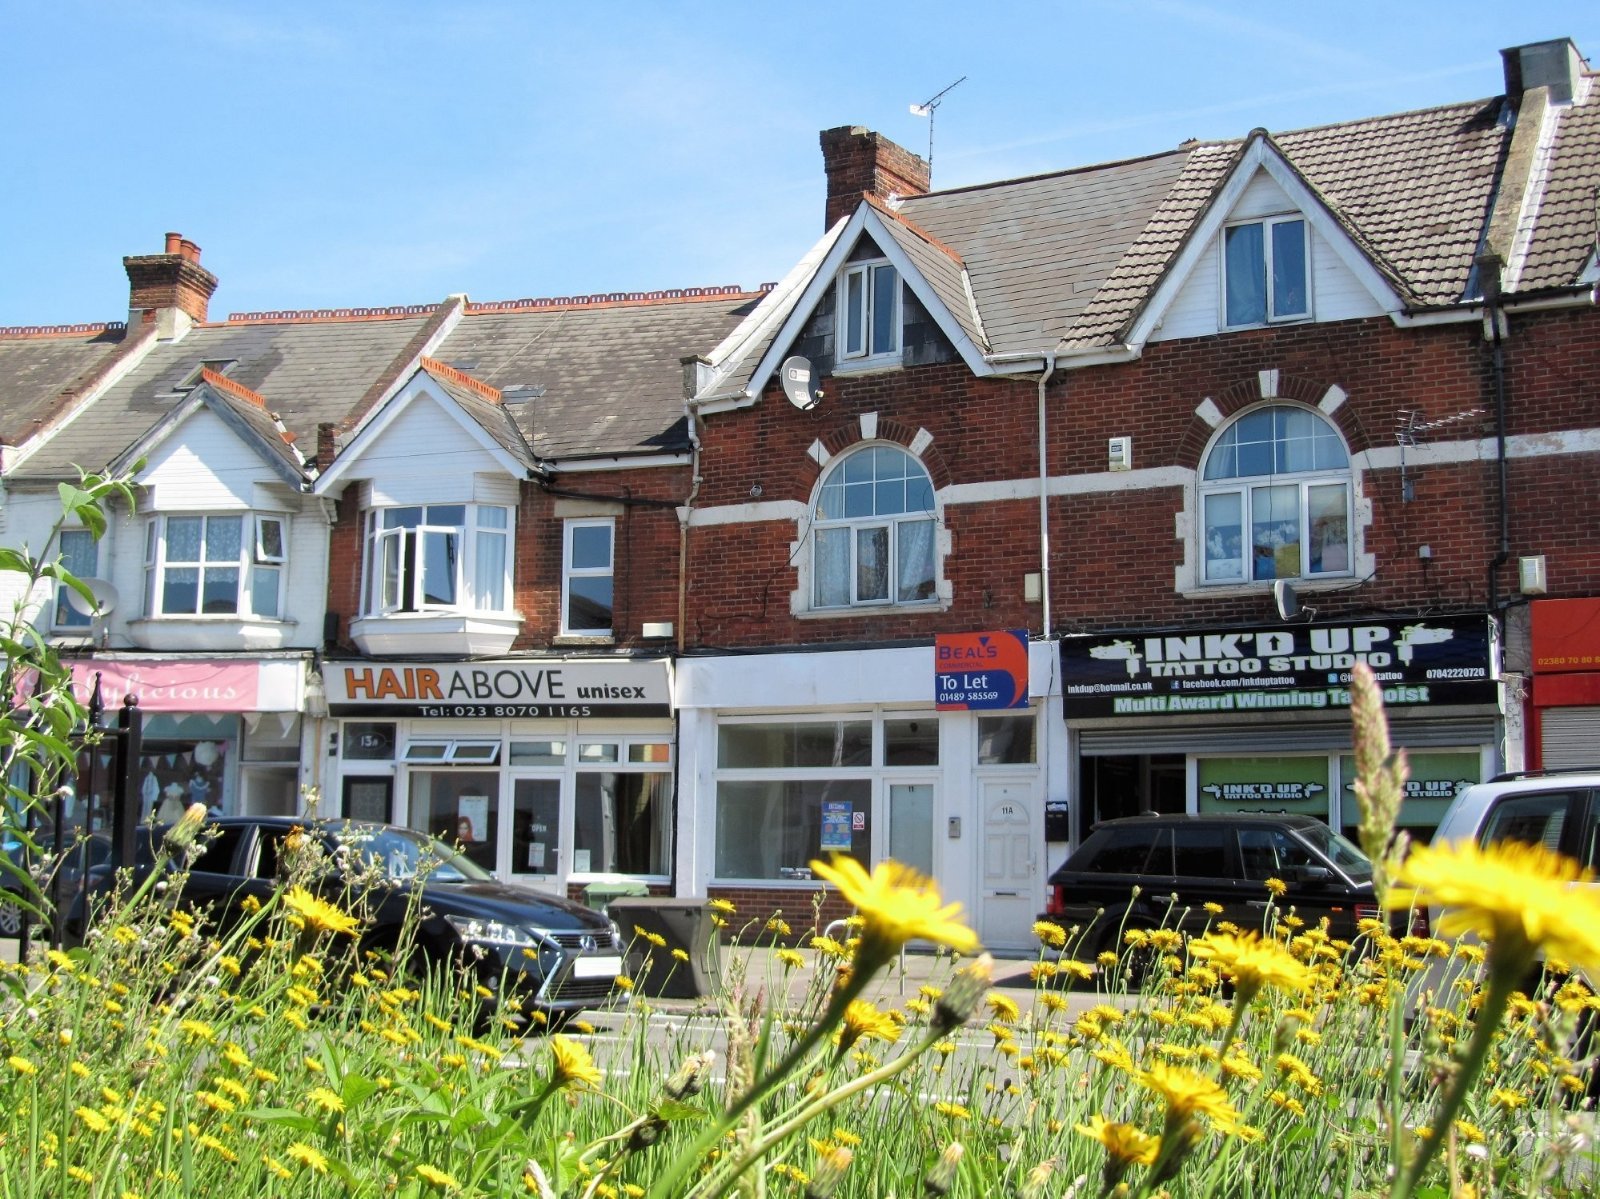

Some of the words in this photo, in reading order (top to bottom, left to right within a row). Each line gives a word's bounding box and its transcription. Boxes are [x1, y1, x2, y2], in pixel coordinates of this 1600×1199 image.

[1144, 631, 1295, 661] INK'D
[1309, 626, 1390, 654] UP
[939, 646, 998, 660] BEALS
[1146, 658, 1262, 677] TATTOO
[1268, 651, 1391, 672] STUDIO
[345, 667, 445, 700] HAIR
[448, 669, 566, 700] ABOVE
[576, 683, 647, 699] unisex
[940, 675, 958, 690] To
[964, 674, 989, 689] Let
[1067, 682, 1153, 694] inkdup@hotmail.co.uk
[1182, 676, 1295, 689] facebook.com/inkduptattoo
[940, 692, 965, 702] 01489
[967, 691, 998, 701] 585569
[1114, 695, 1167, 713] Multi
[1168, 694, 1234, 712] Award
[1234, 690, 1326, 707] Winning
[418, 706, 450, 717] Tel:
[454, 706, 487, 717] 023
[494, 706, 539, 717] 8070
[549, 706, 591, 717] 1165
[1223, 784, 1273, 794] INK'D
[1277, 783, 1302, 793] UP
[1425, 781, 1452, 791] UP
